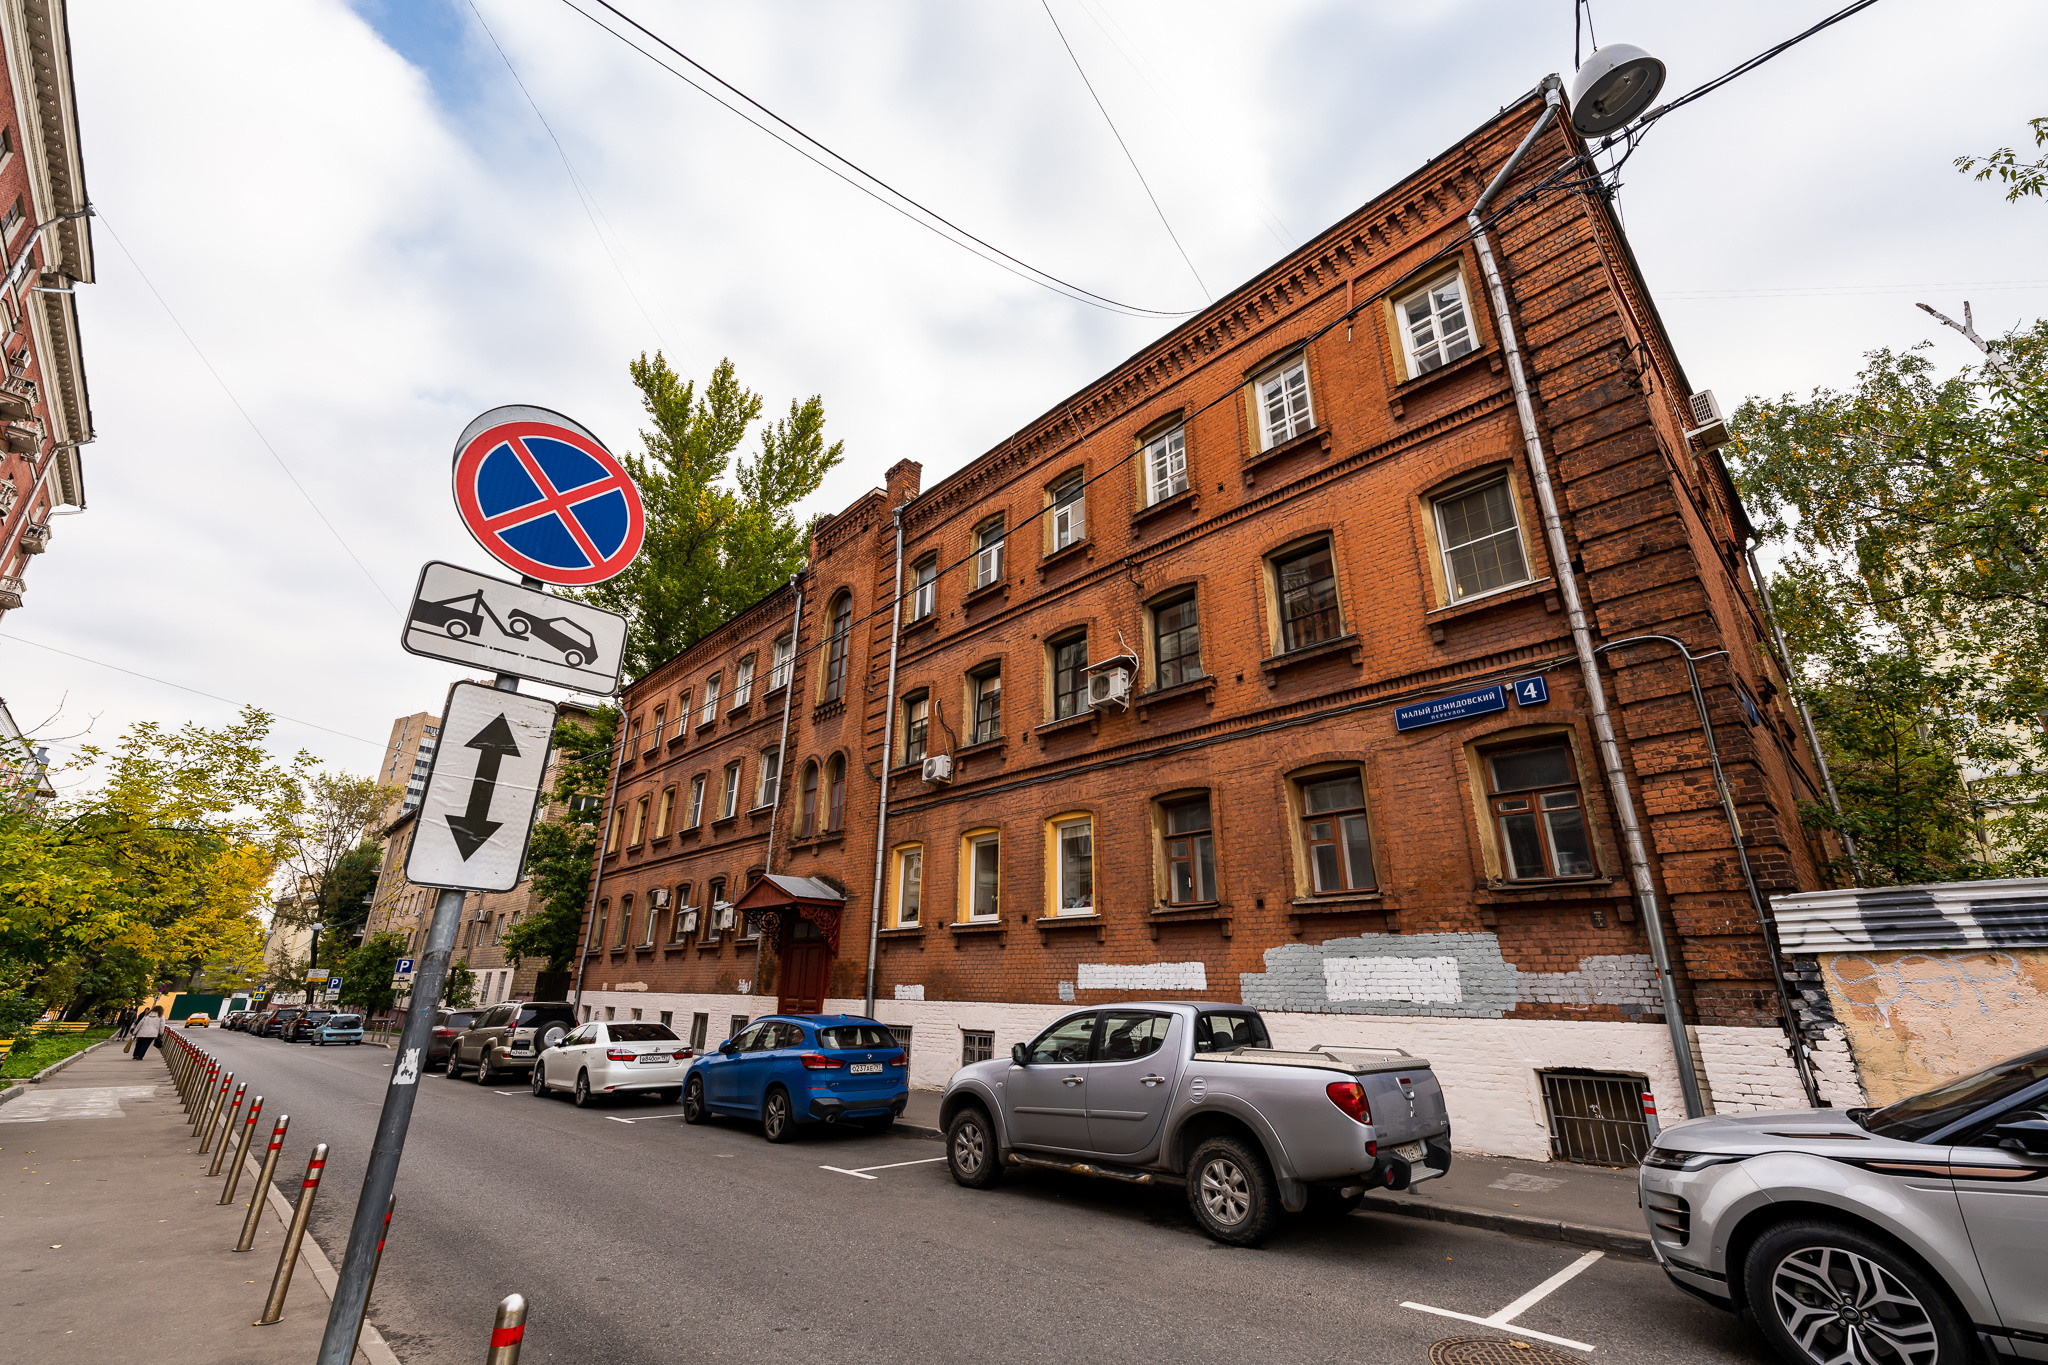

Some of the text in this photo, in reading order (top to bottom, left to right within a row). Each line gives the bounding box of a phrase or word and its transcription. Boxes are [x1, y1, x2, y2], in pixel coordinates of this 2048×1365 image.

[1523, 682, 1538, 699] 4
[1401, 691, 1496, 720] МАЛЫЙ ДЕМИДОВСКИЙ
[1430, 708, 1466, 720] ПЕРЕУЛОК
[399, 960, 410, 972] P
[330, 978, 339, 988] P
